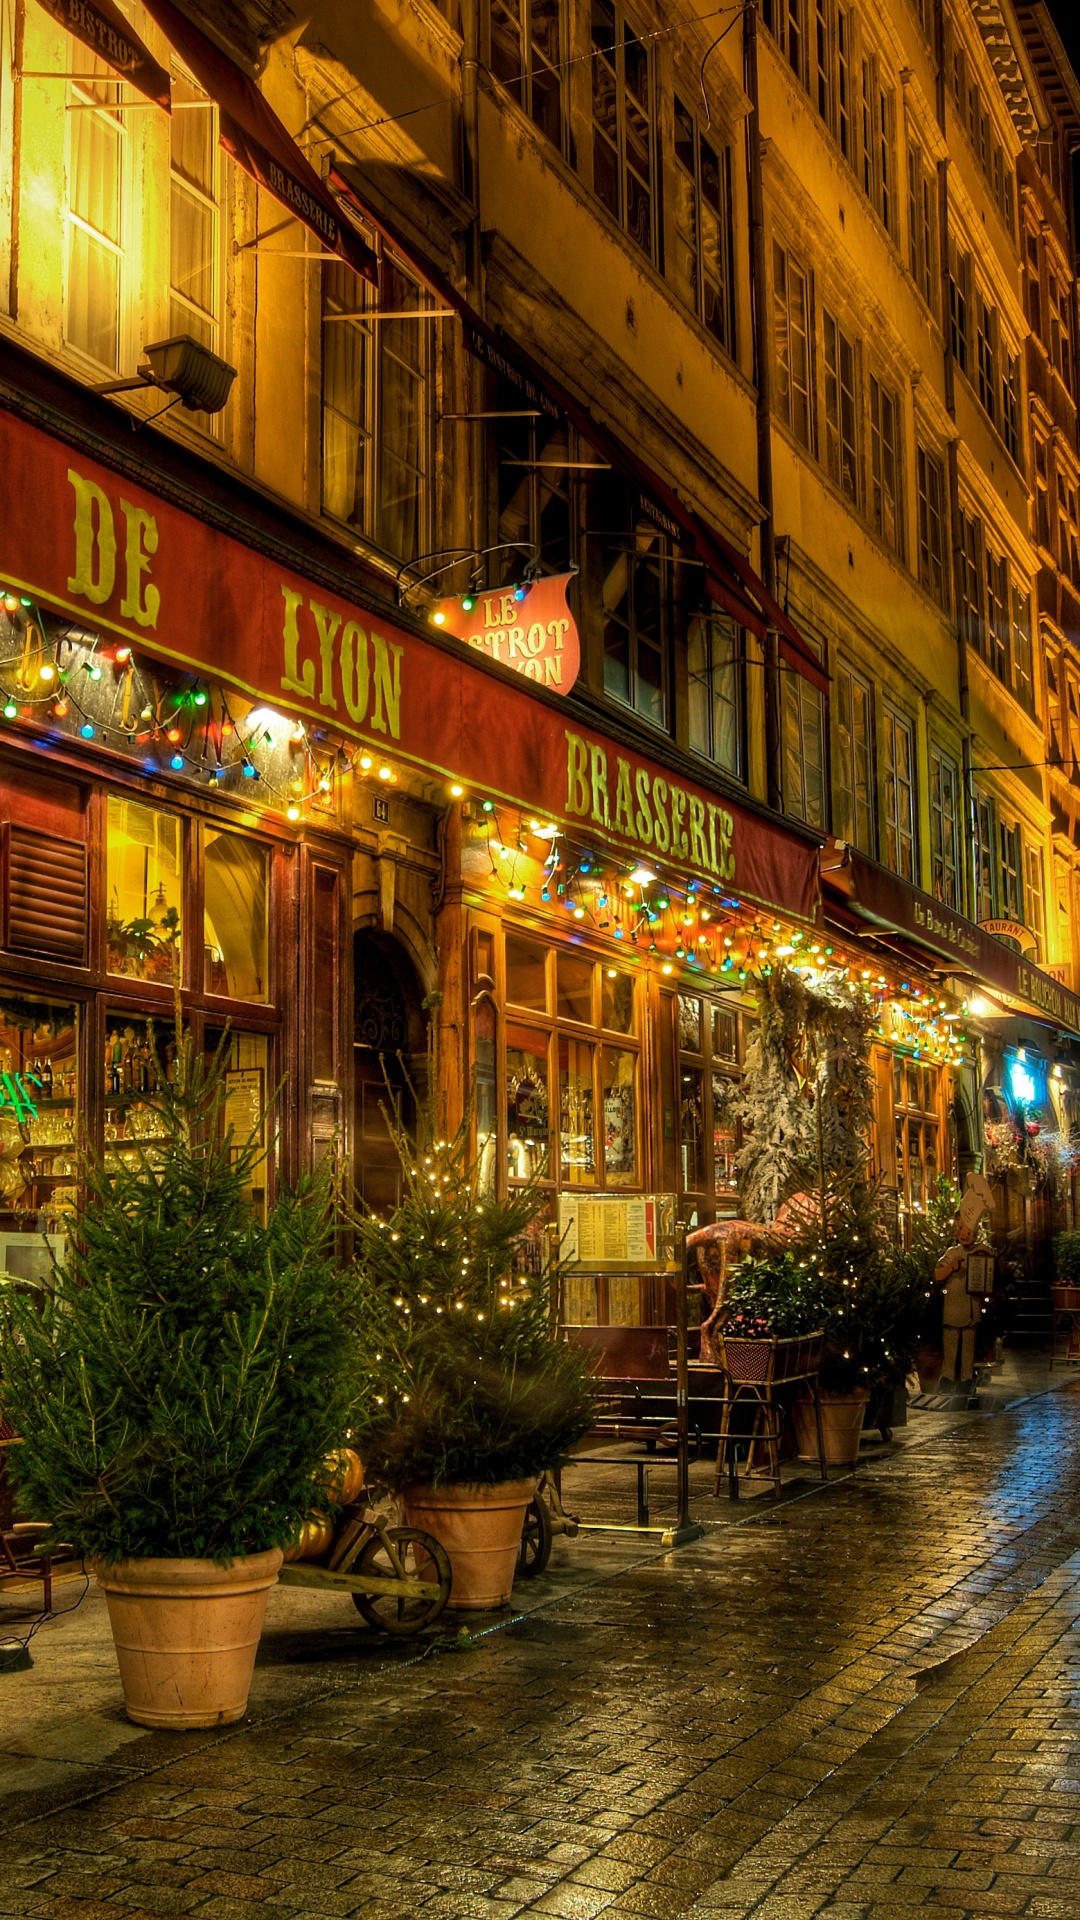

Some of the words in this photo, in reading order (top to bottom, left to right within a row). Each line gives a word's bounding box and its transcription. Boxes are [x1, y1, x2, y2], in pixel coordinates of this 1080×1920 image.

[67, 0, 139, 71] BISTROT
[268, 162, 336, 241] BRASSERIE
[483, 594, 518, 629] LE
[460, 618, 569, 660] STROT
[67, 468, 161, 631] DE
[281, 584, 404, 740] LYON
[565, 729, 736, 881] BRASSERIE
[507, 654, 563, 687] ON
[983, 922, 1026, 938] TAURANT
[1018, 966, 1029, 997] LE
